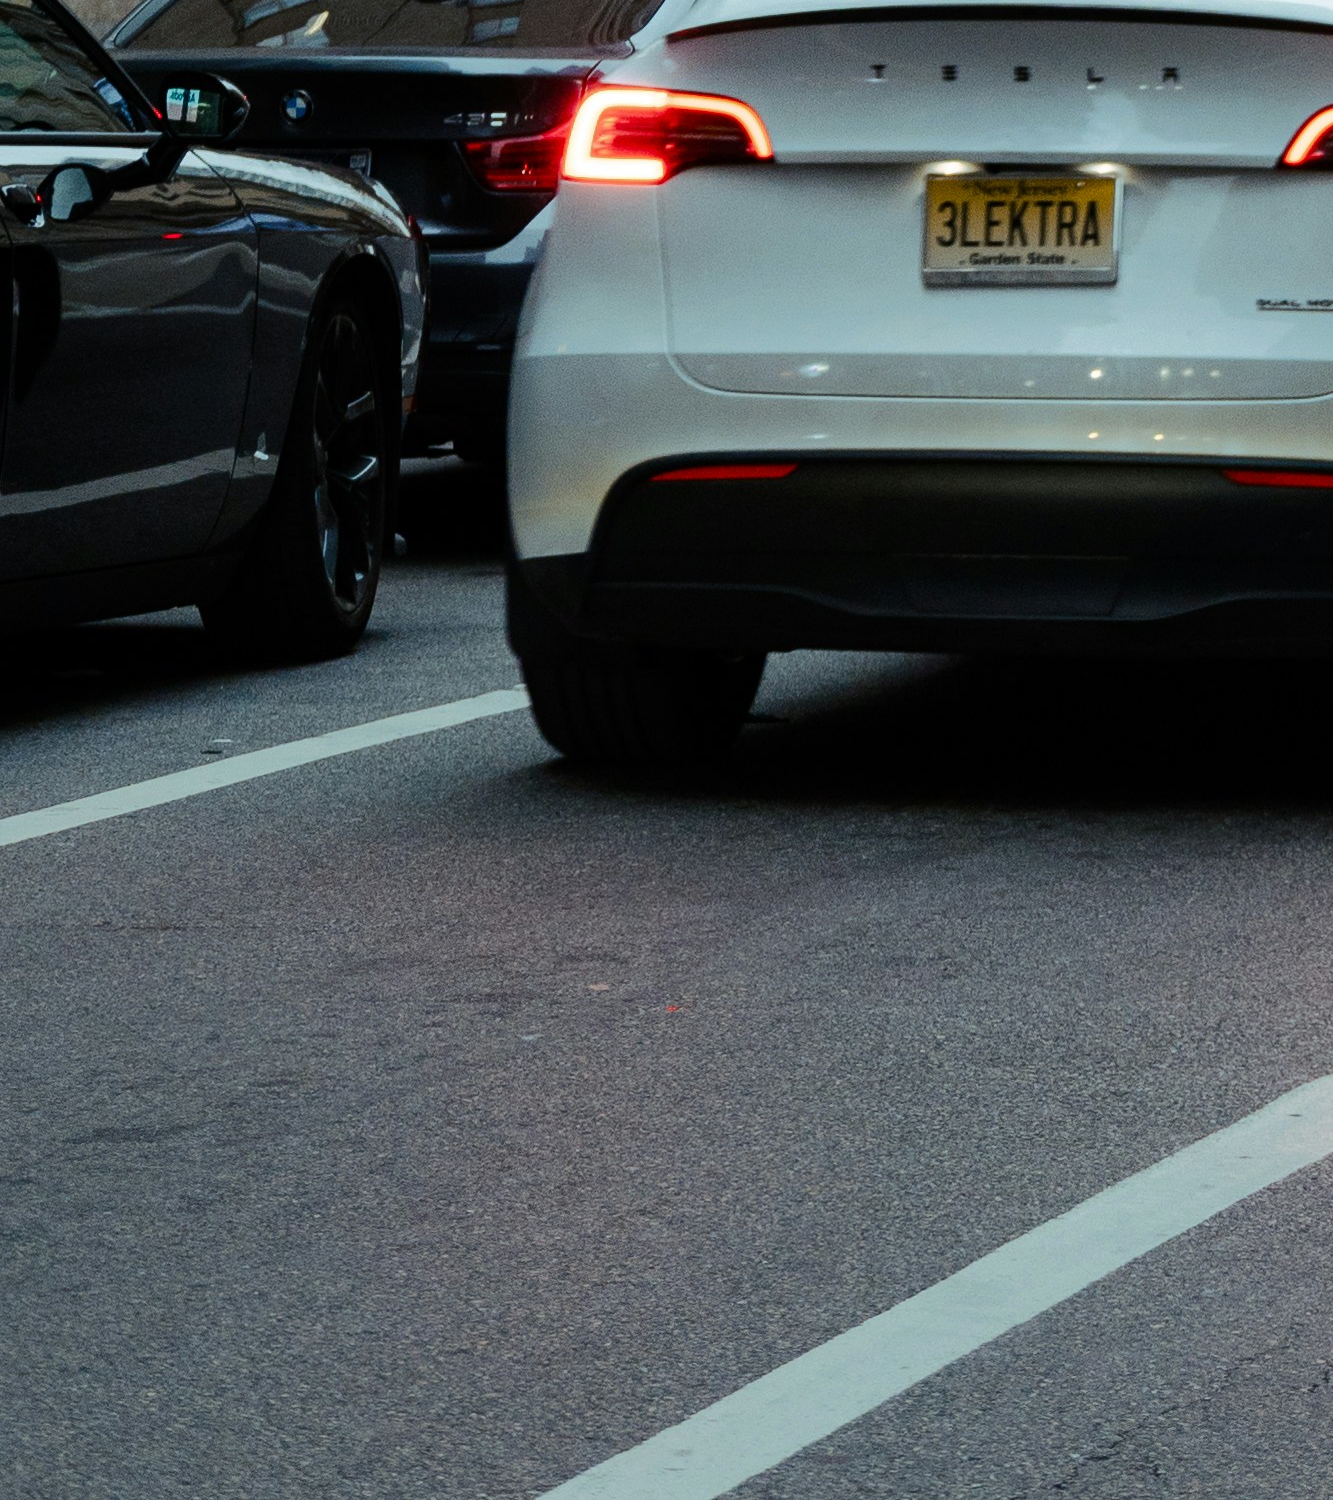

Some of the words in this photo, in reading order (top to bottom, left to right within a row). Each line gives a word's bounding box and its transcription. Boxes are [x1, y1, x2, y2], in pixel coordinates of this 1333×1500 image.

[869, 63, 1180, 83] TESLA
[936, 200, 1101, 248] 3LEKTRA
[969, 252, 1021, 265] Garden
[1027, 251, 1065, 265] State
